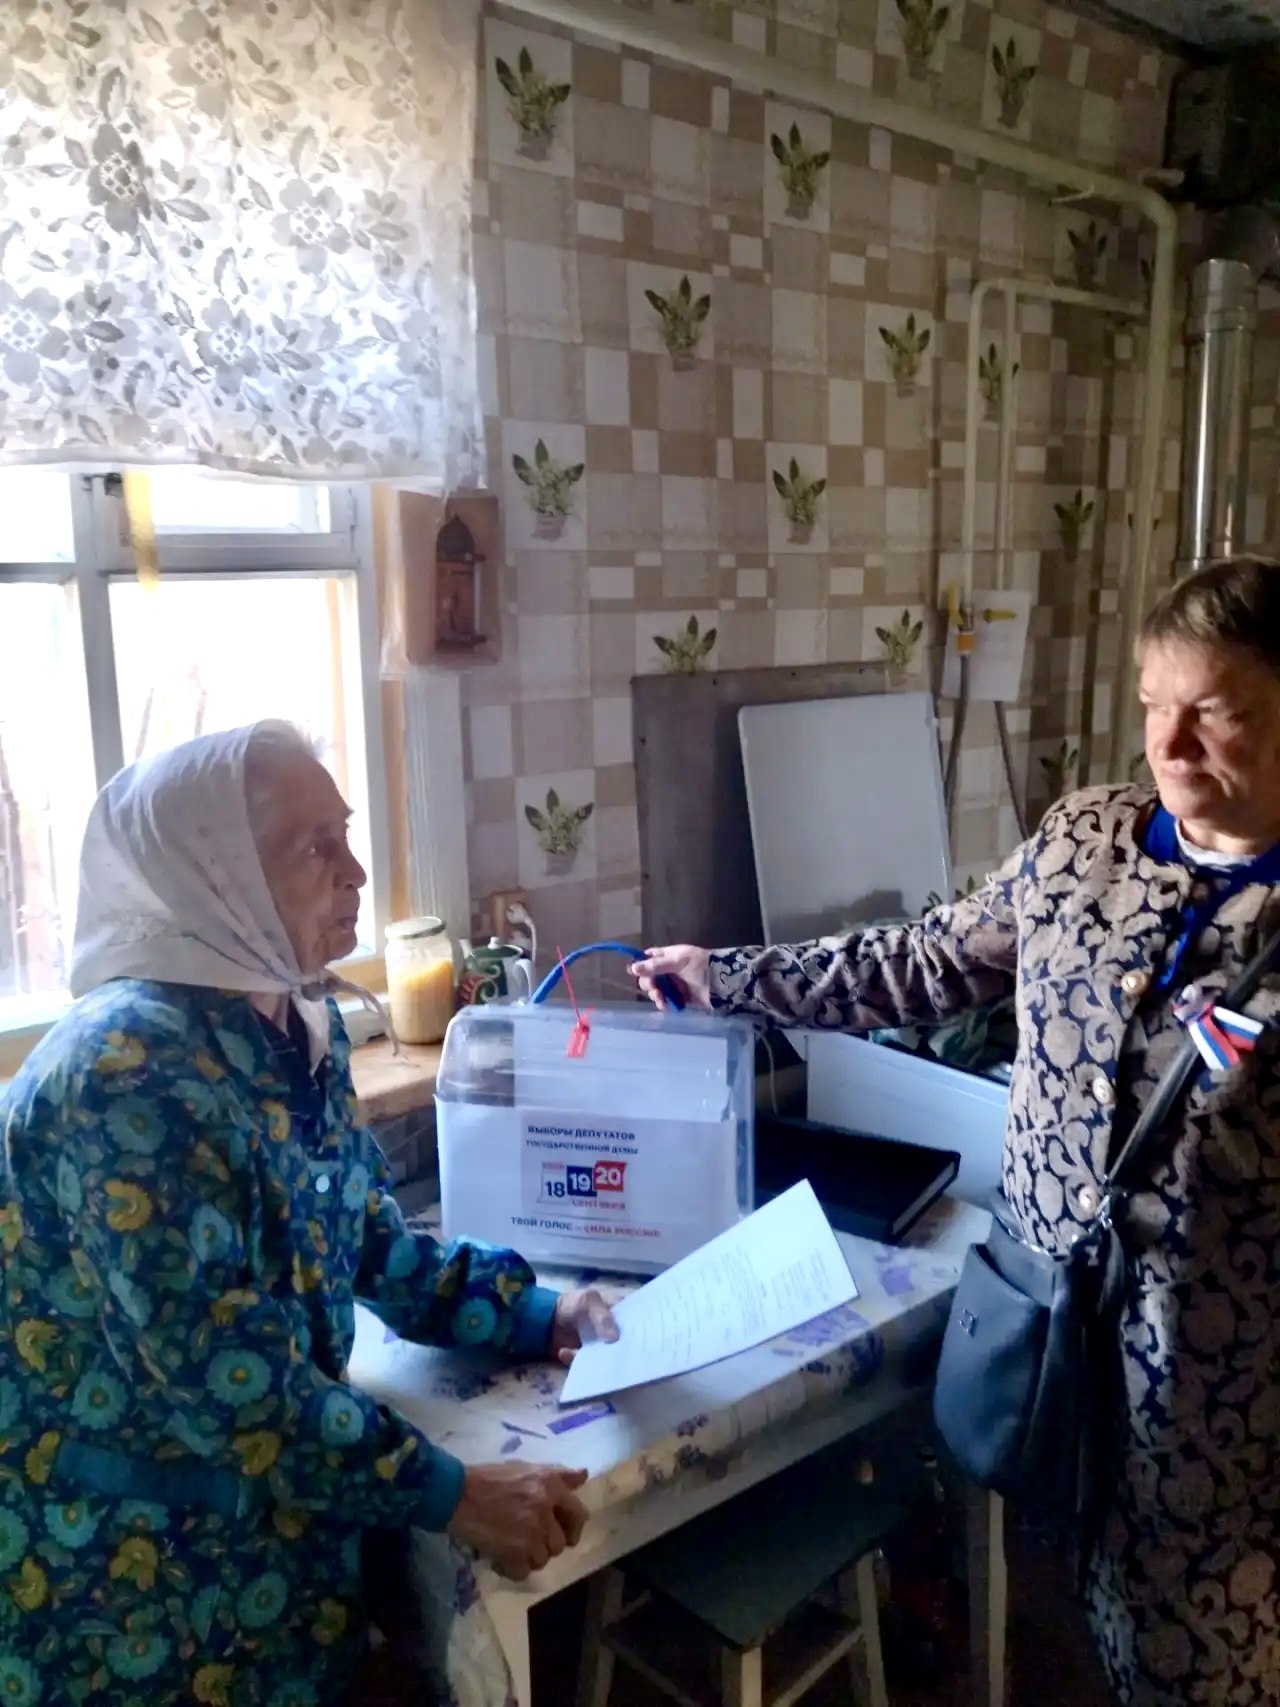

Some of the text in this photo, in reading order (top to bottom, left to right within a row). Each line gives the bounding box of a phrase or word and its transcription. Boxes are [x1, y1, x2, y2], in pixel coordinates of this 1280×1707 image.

[527, 1125, 636, 1141] ВЫБОРЫ ДЕПУТАТОВ
[545, 1166, 622, 1198] 18 19 20
[511, 1216, 538, 1227] ТВОЙ
[539, 1219, 573, 1231] ГОЛОС
